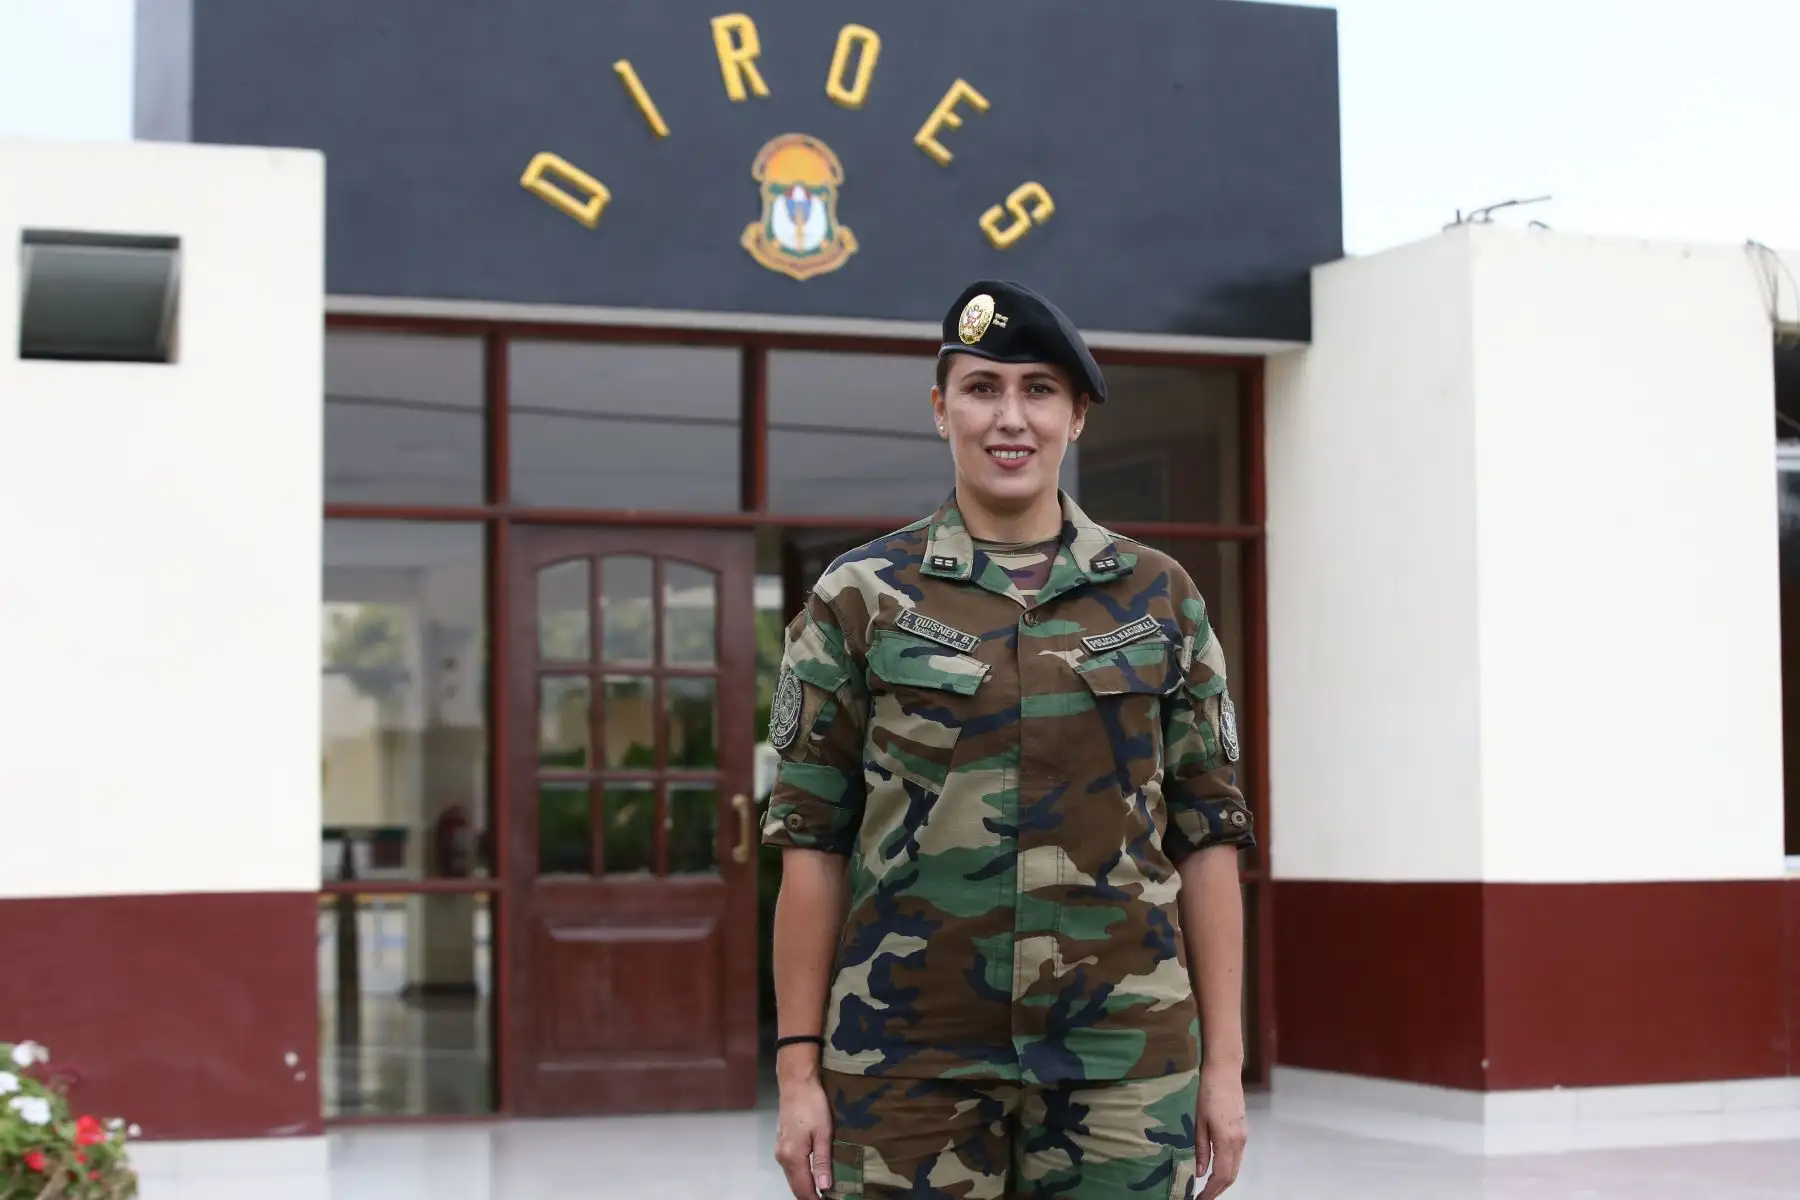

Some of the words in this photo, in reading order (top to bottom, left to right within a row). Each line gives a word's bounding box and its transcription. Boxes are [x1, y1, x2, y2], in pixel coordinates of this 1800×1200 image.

[520, 12, 1055, 249] DIROES
[903, 612, 911, 622] Z.
[914, 617, 958, 639] QUISNER
[961, 636, 970, 645] B.
[1089, 635, 1118, 648] POLICIA
[1117, 620, 1155, 640] NACIONAL
